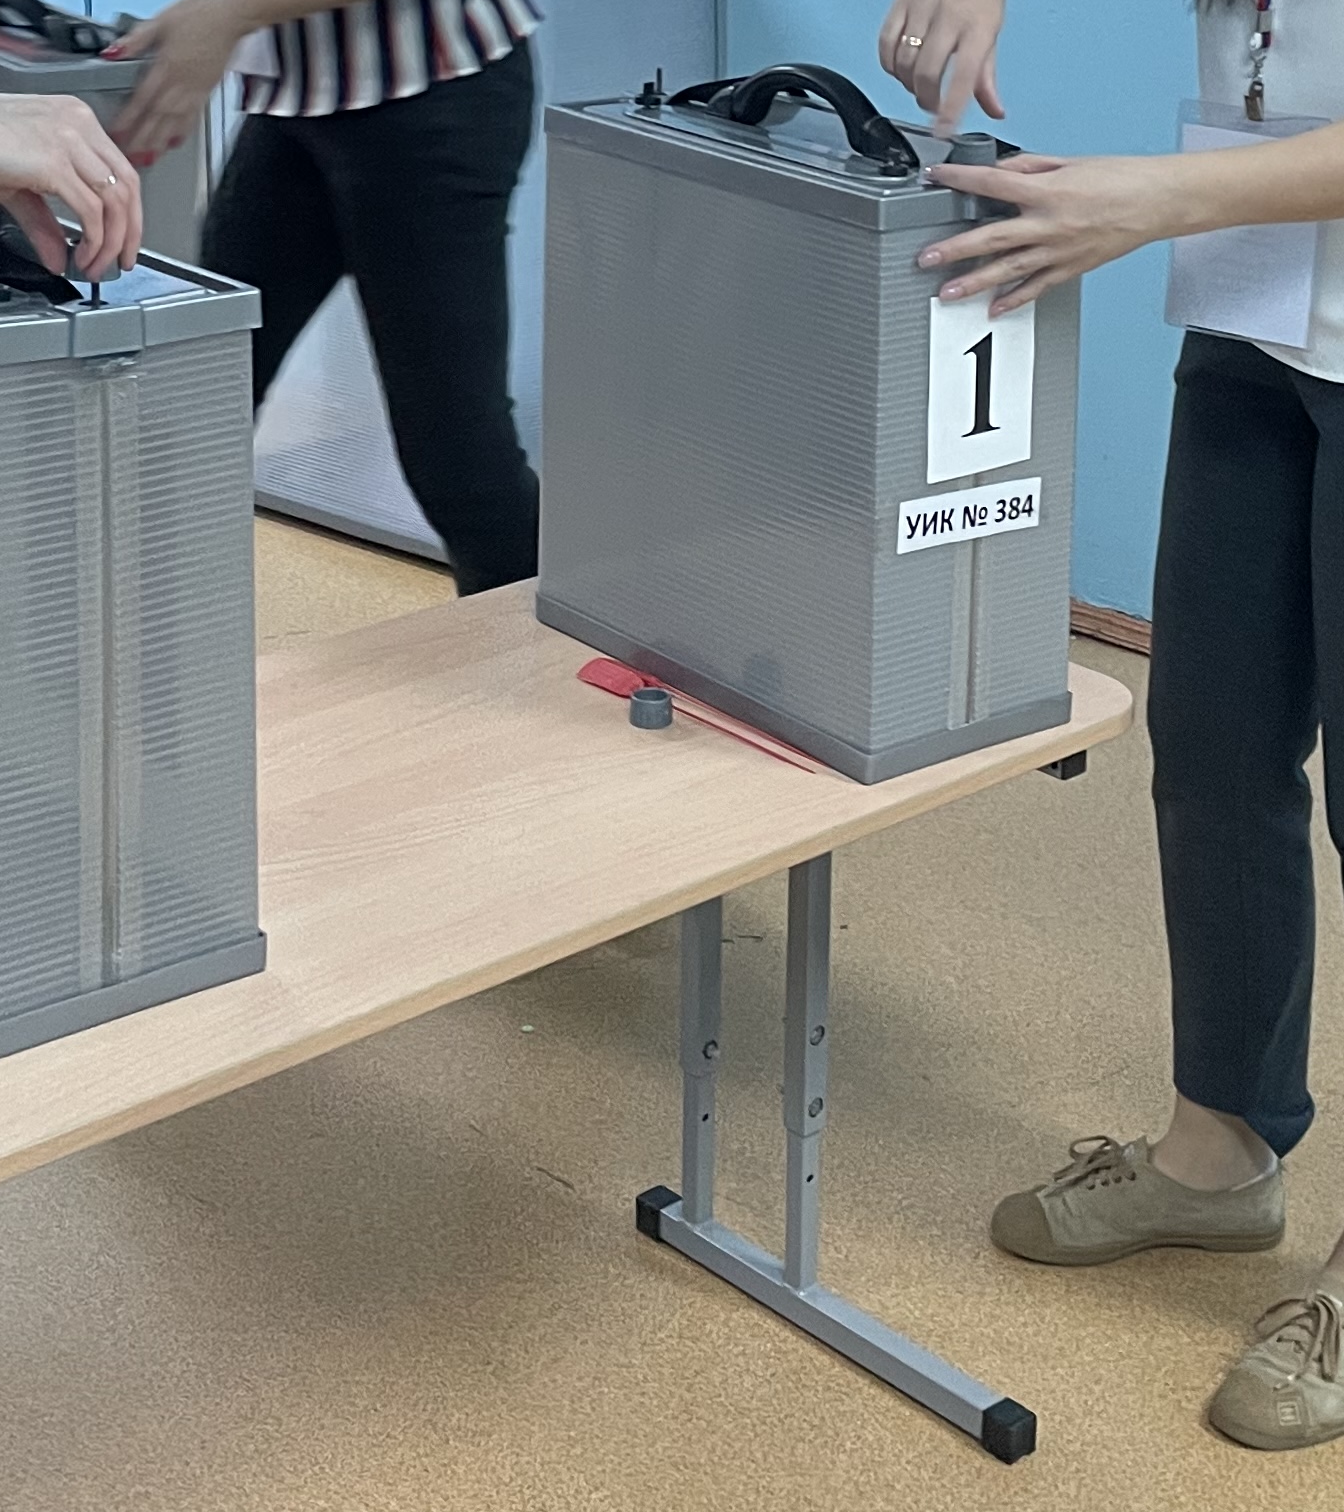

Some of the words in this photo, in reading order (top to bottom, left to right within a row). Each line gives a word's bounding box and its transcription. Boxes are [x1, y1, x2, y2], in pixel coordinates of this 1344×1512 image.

[961, 331, 1001, 438] 1
[906, 508, 955, 540] УИК
[962, 503, 988, 530] №
[994, 494, 1034, 524] 384
